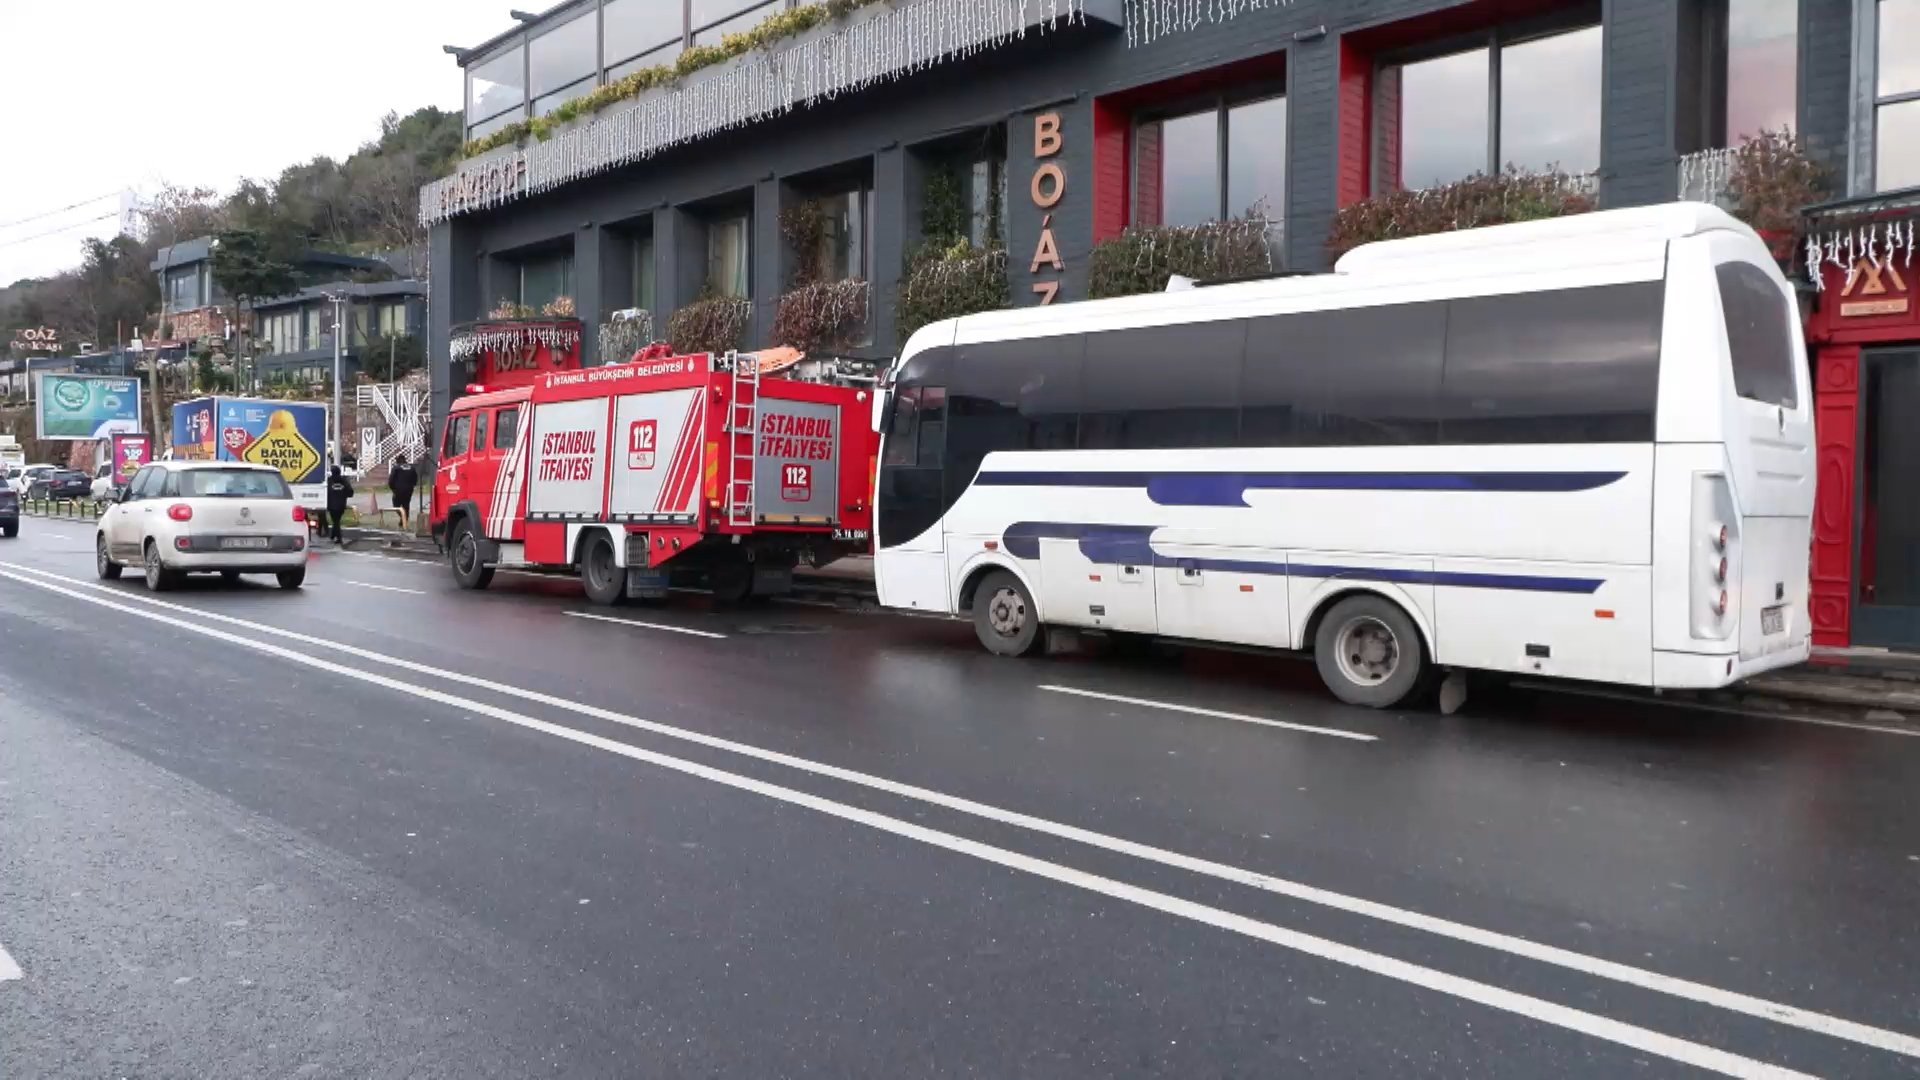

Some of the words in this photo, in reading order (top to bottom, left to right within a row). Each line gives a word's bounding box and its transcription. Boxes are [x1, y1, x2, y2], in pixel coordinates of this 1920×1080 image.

[270, 439, 294, 448] YOL
[633, 425, 653, 450] 112
[260, 449, 303, 458] BAKIM
[785, 467, 808, 485] 112
